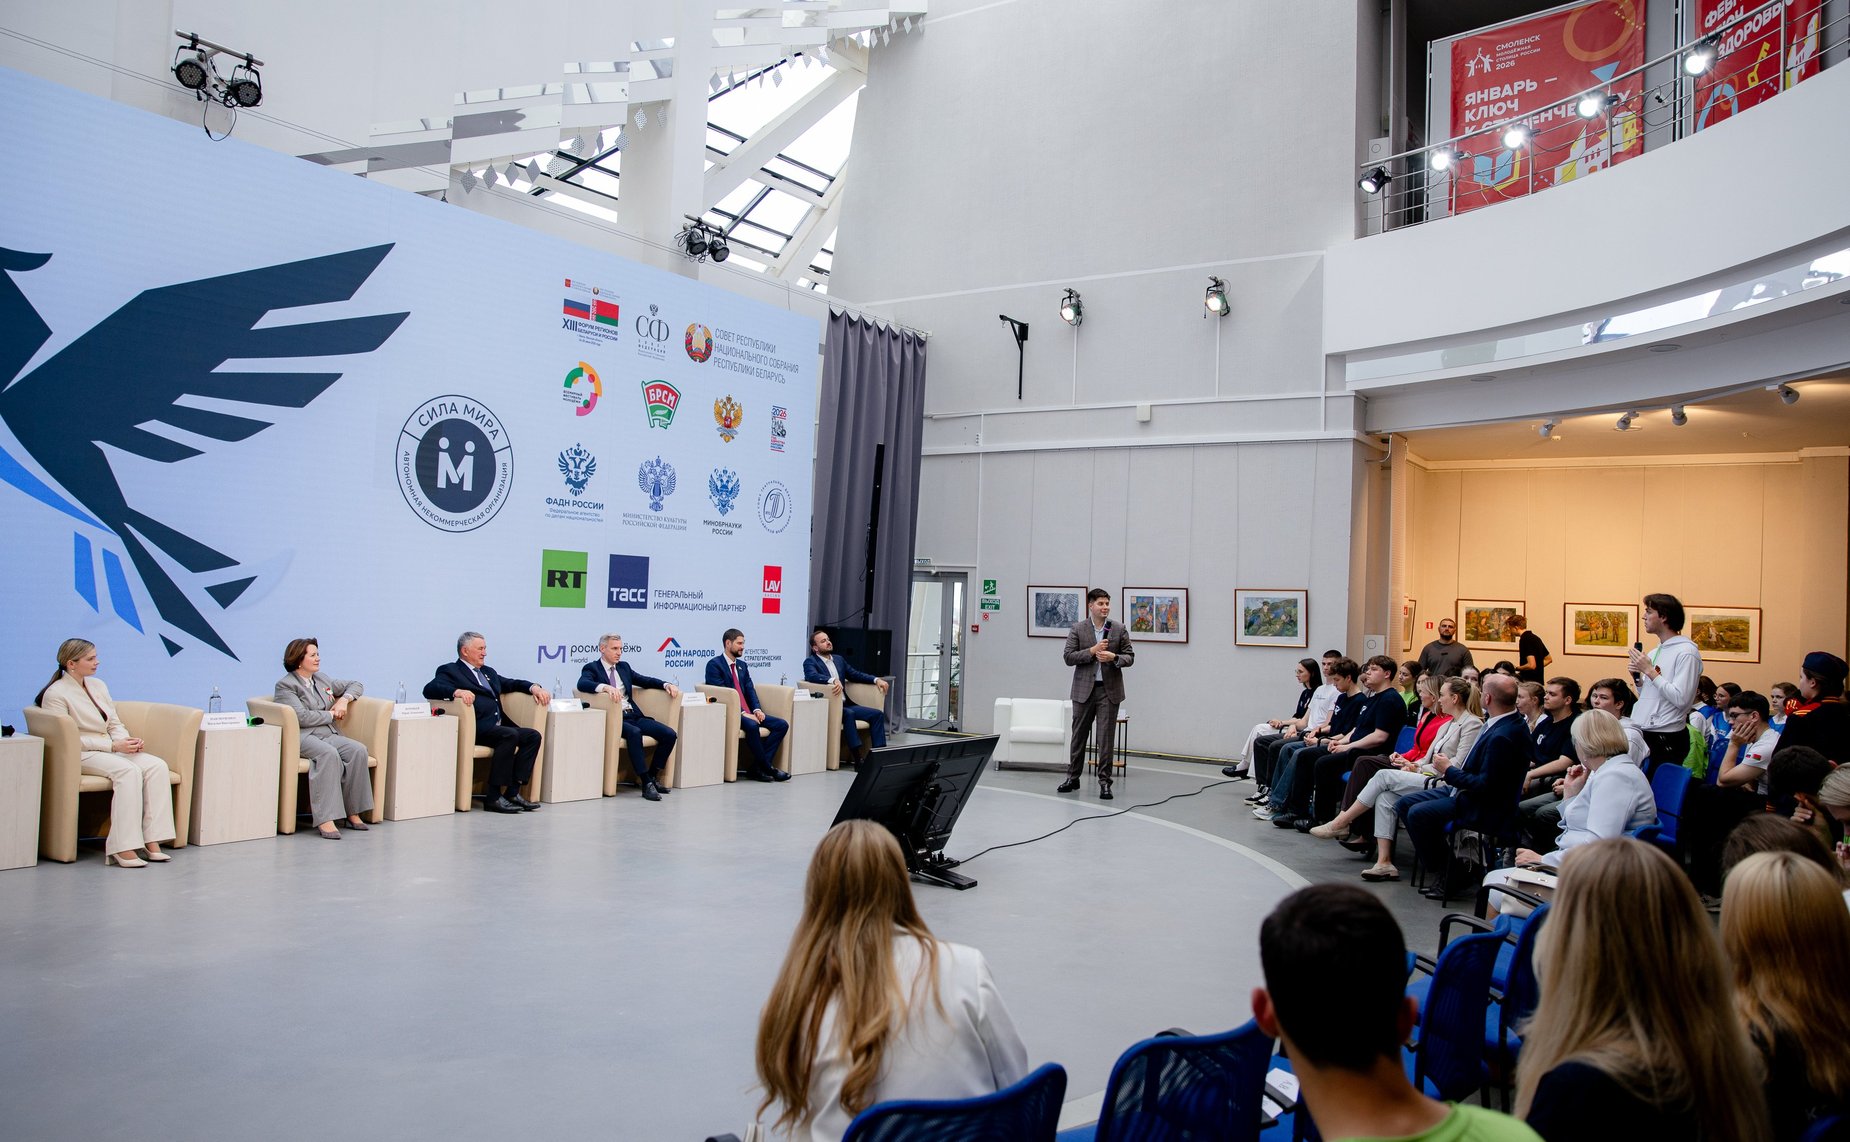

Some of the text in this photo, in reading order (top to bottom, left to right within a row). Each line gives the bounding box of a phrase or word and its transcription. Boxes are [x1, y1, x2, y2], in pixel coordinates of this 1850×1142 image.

[1718, 0, 1794, 59] ЗДОРОВЬ
[1496, 34, 1541, 51] СМОЛЕНСК
[1496, 48, 1541, 62] СТОЛИЦА РОССИИ
[1496, 60, 1516, 70] 2026
[1465, 78, 1538, 106] ЯНВАРЬ
[1465, 98, 1519, 123] КЛЮЧ
[562, 317, 578, 332] XIII
[578, 321, 618, 336] ФОРУМ РЕГИОНОВ
[636, 315, 670, 343] СФ
[577, 328, 599, 337] БЕЛАРУСИ
[715, 328, 776, 354] СОВЕТ РЕСПУБЛИКИ
[714, 343, 799, 374] НАЦИОНАЛЬНОГО СОБРАНИЯ
[713, 357, 786, 384] РЕСПУБЛИКИ БЕЛАРУСЬ
[649, 388, 676, 407] БРСМ
[771, 407, 787, 418] 2026
[418, 402, 499, 440] СИЛА МИРА
[403, 450, 507, 527] АВТОНОМНАЯ НЕКОММЕРЧЕСКАЯ ОРГАНИЗАЦИЯ
[545, 497, 604, 511] ФАДН РОССИИ
[622, 512, 663, 522] МИНИСТЕРСТВО
[703, 519, 743, 529] МИНОБРНАУКИ
[622, 519, 687, 531] РОССИЙСКОЙ ФЕДЕРАЦИИ
[712, 528, 733, 536] РОССИИ
[547, 569, 587, 588] RT
[765, 580, 780, 592] LAV
[654, 589, 704, 599] ГЕНЕРАЛЬНЫЙ
[653, 602, 747, 612] ИНФОРМАЦИОНЫЙ ПАРТНЕР
[570, 643, 642, 656] росмёжь
[665, 649, 715, 658] ДОМ НАРОДОВ
[665, 660, 694, 668] РОССИИ
